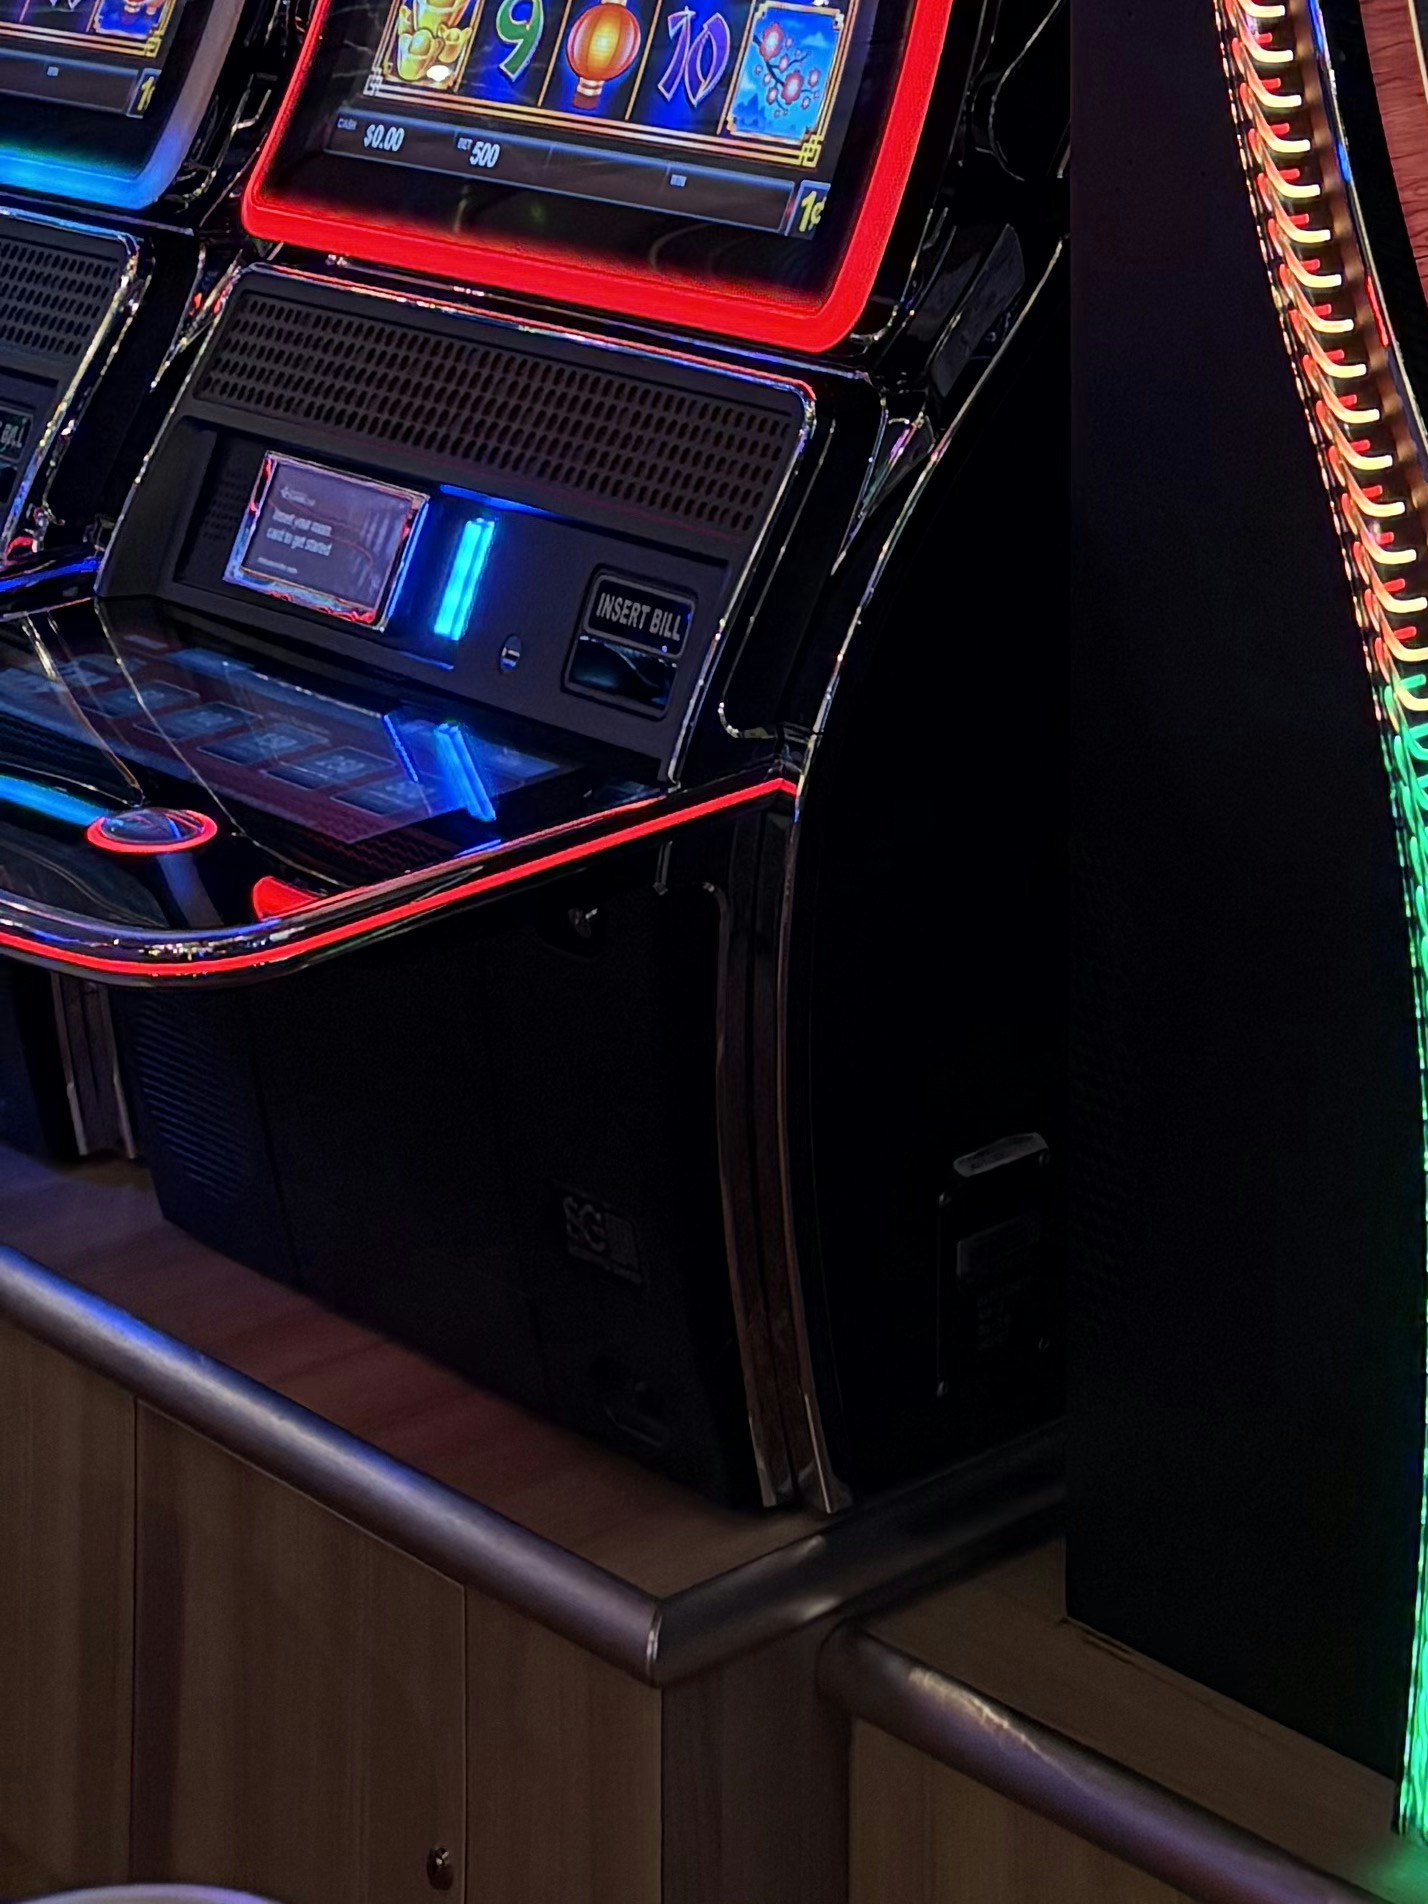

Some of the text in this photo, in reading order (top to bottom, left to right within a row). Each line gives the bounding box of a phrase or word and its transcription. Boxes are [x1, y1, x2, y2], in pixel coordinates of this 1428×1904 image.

[657, 5, 731, 108] 10
[363, 124, 405, 152] $0.00
[469, 139, 502, 169] 500
[596, 592, 682, 642] INSERT BILL
